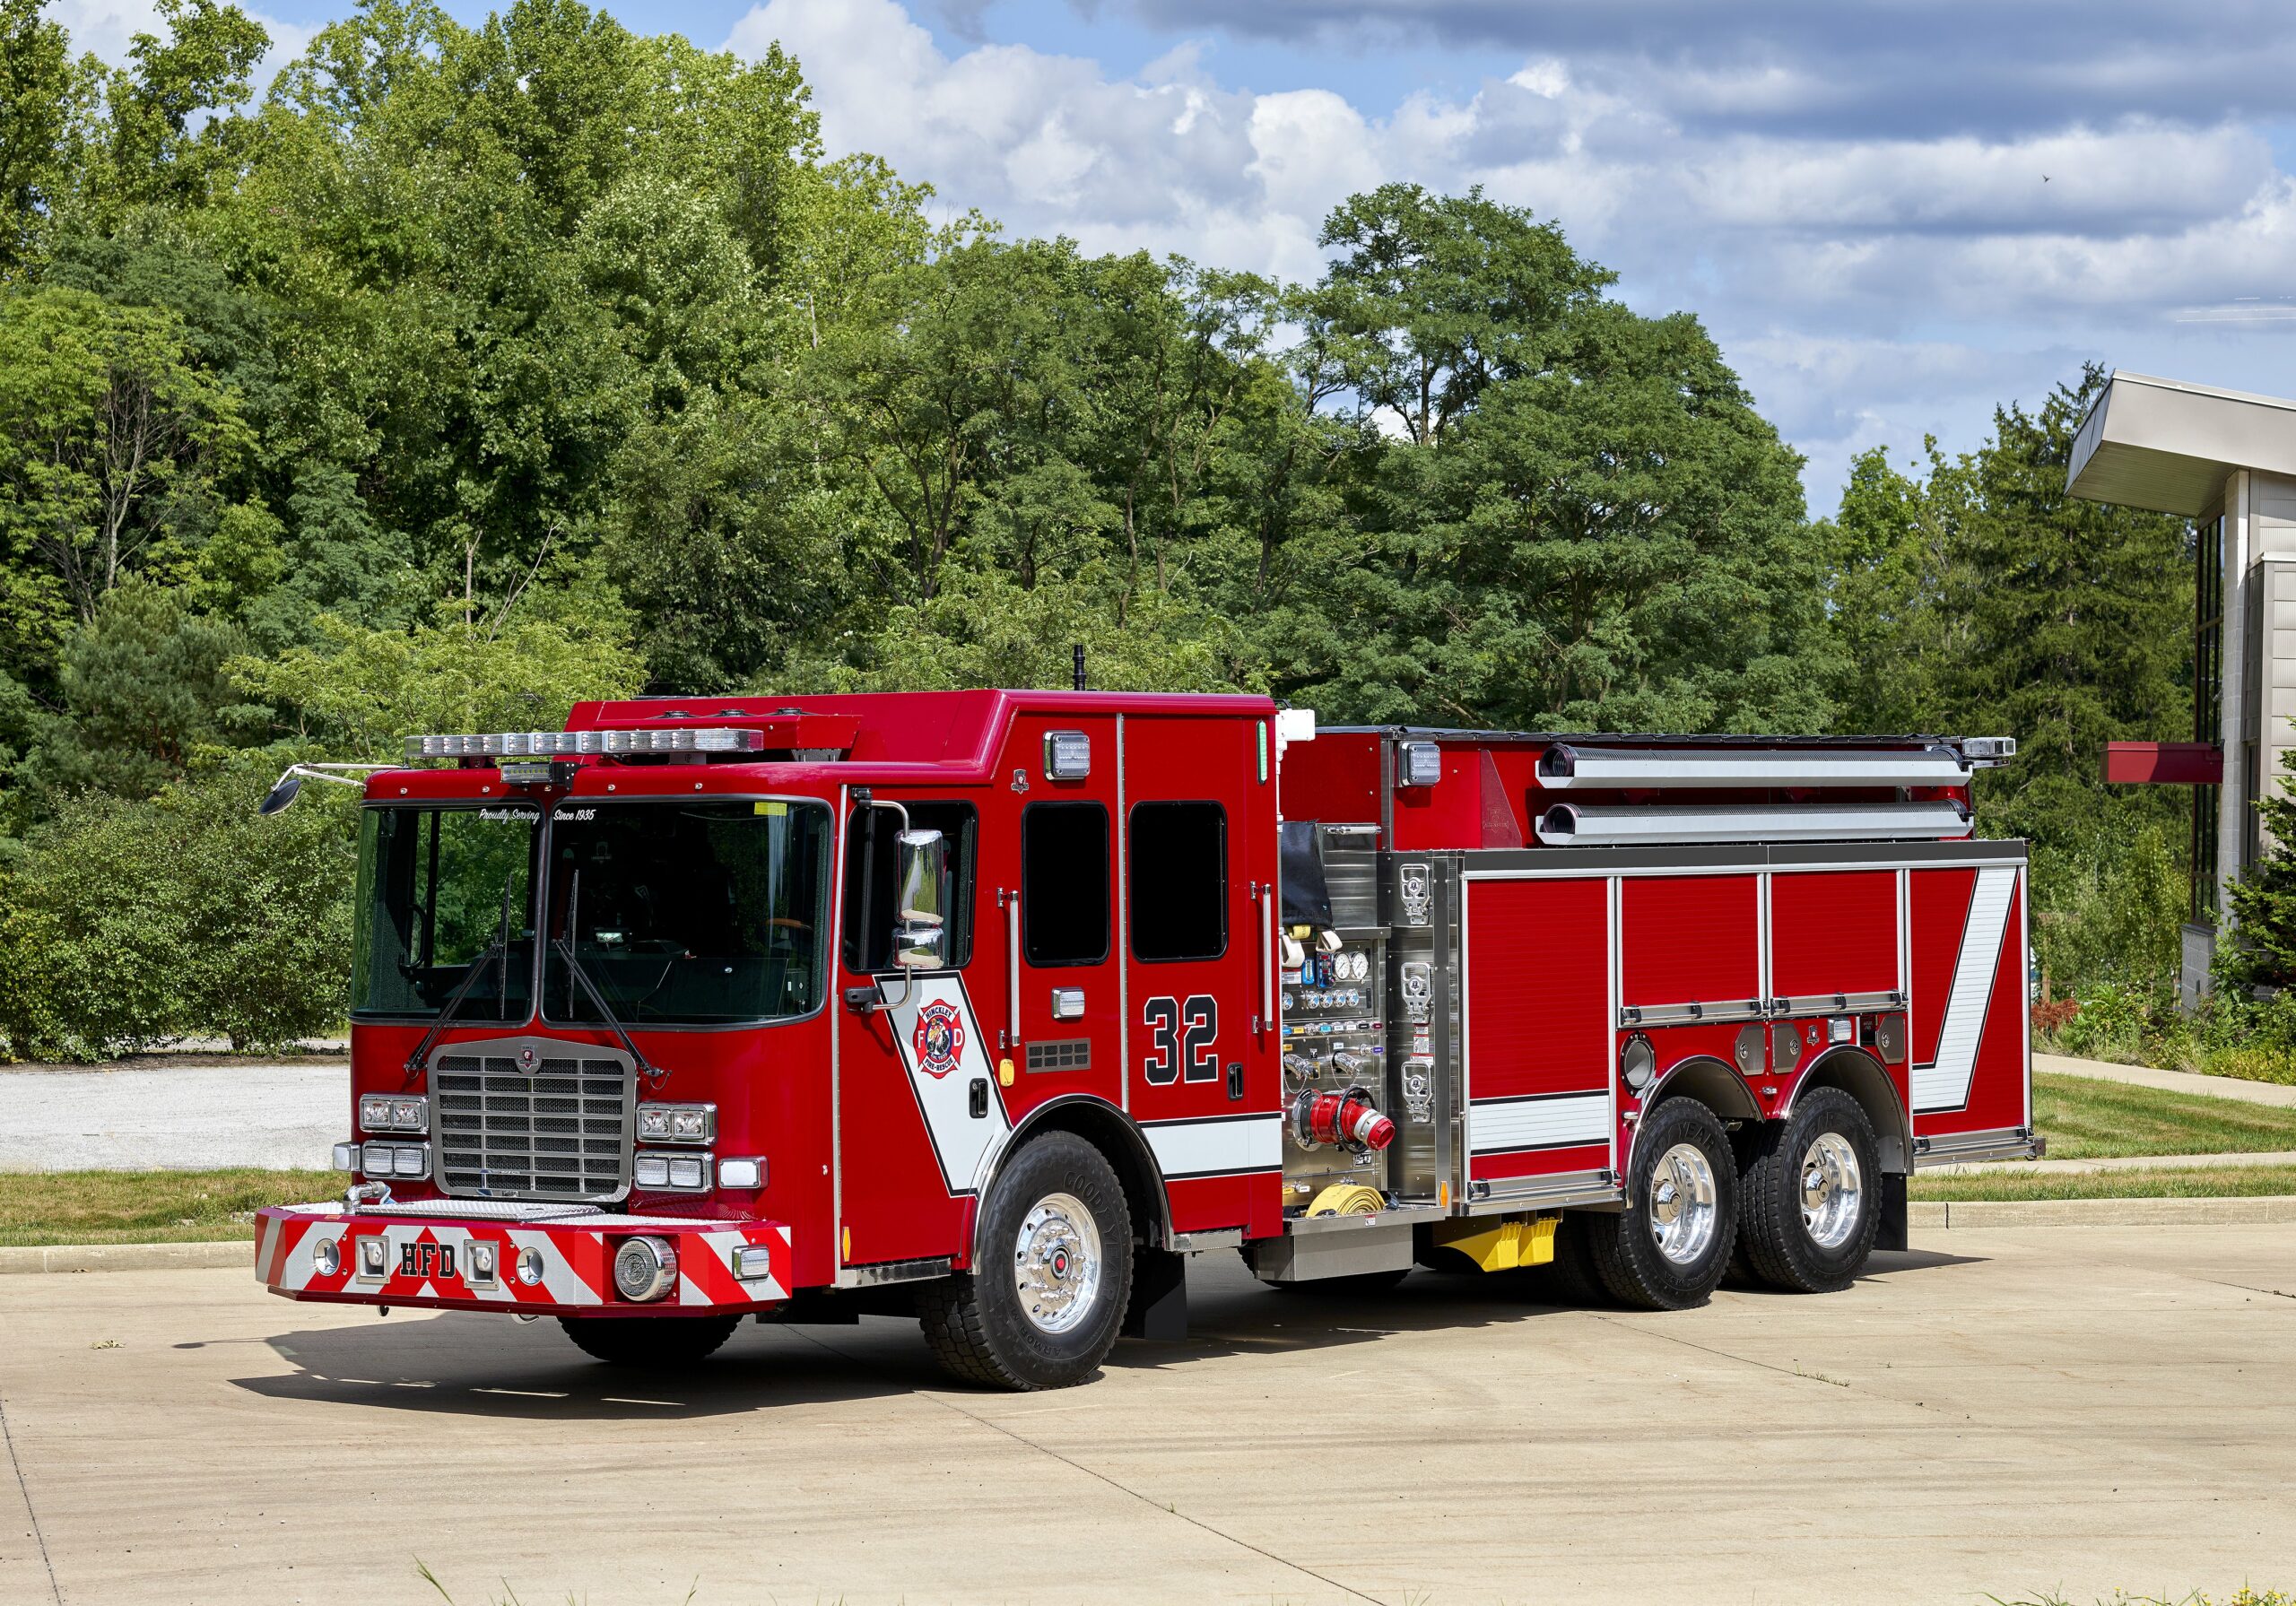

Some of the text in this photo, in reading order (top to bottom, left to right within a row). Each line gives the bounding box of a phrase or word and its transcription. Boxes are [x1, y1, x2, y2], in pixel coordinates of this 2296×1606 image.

[479, 809, 540, 825] Proudly Serving
[552, 809, 596, 820] Since 1935
[926, 1006, 952, 1020] HINCKLEY
[918, 1029, 963, 1048] F D
[1144, 994, 1219, 1086] 32
[400, 1242, 456, 1278] HFD
